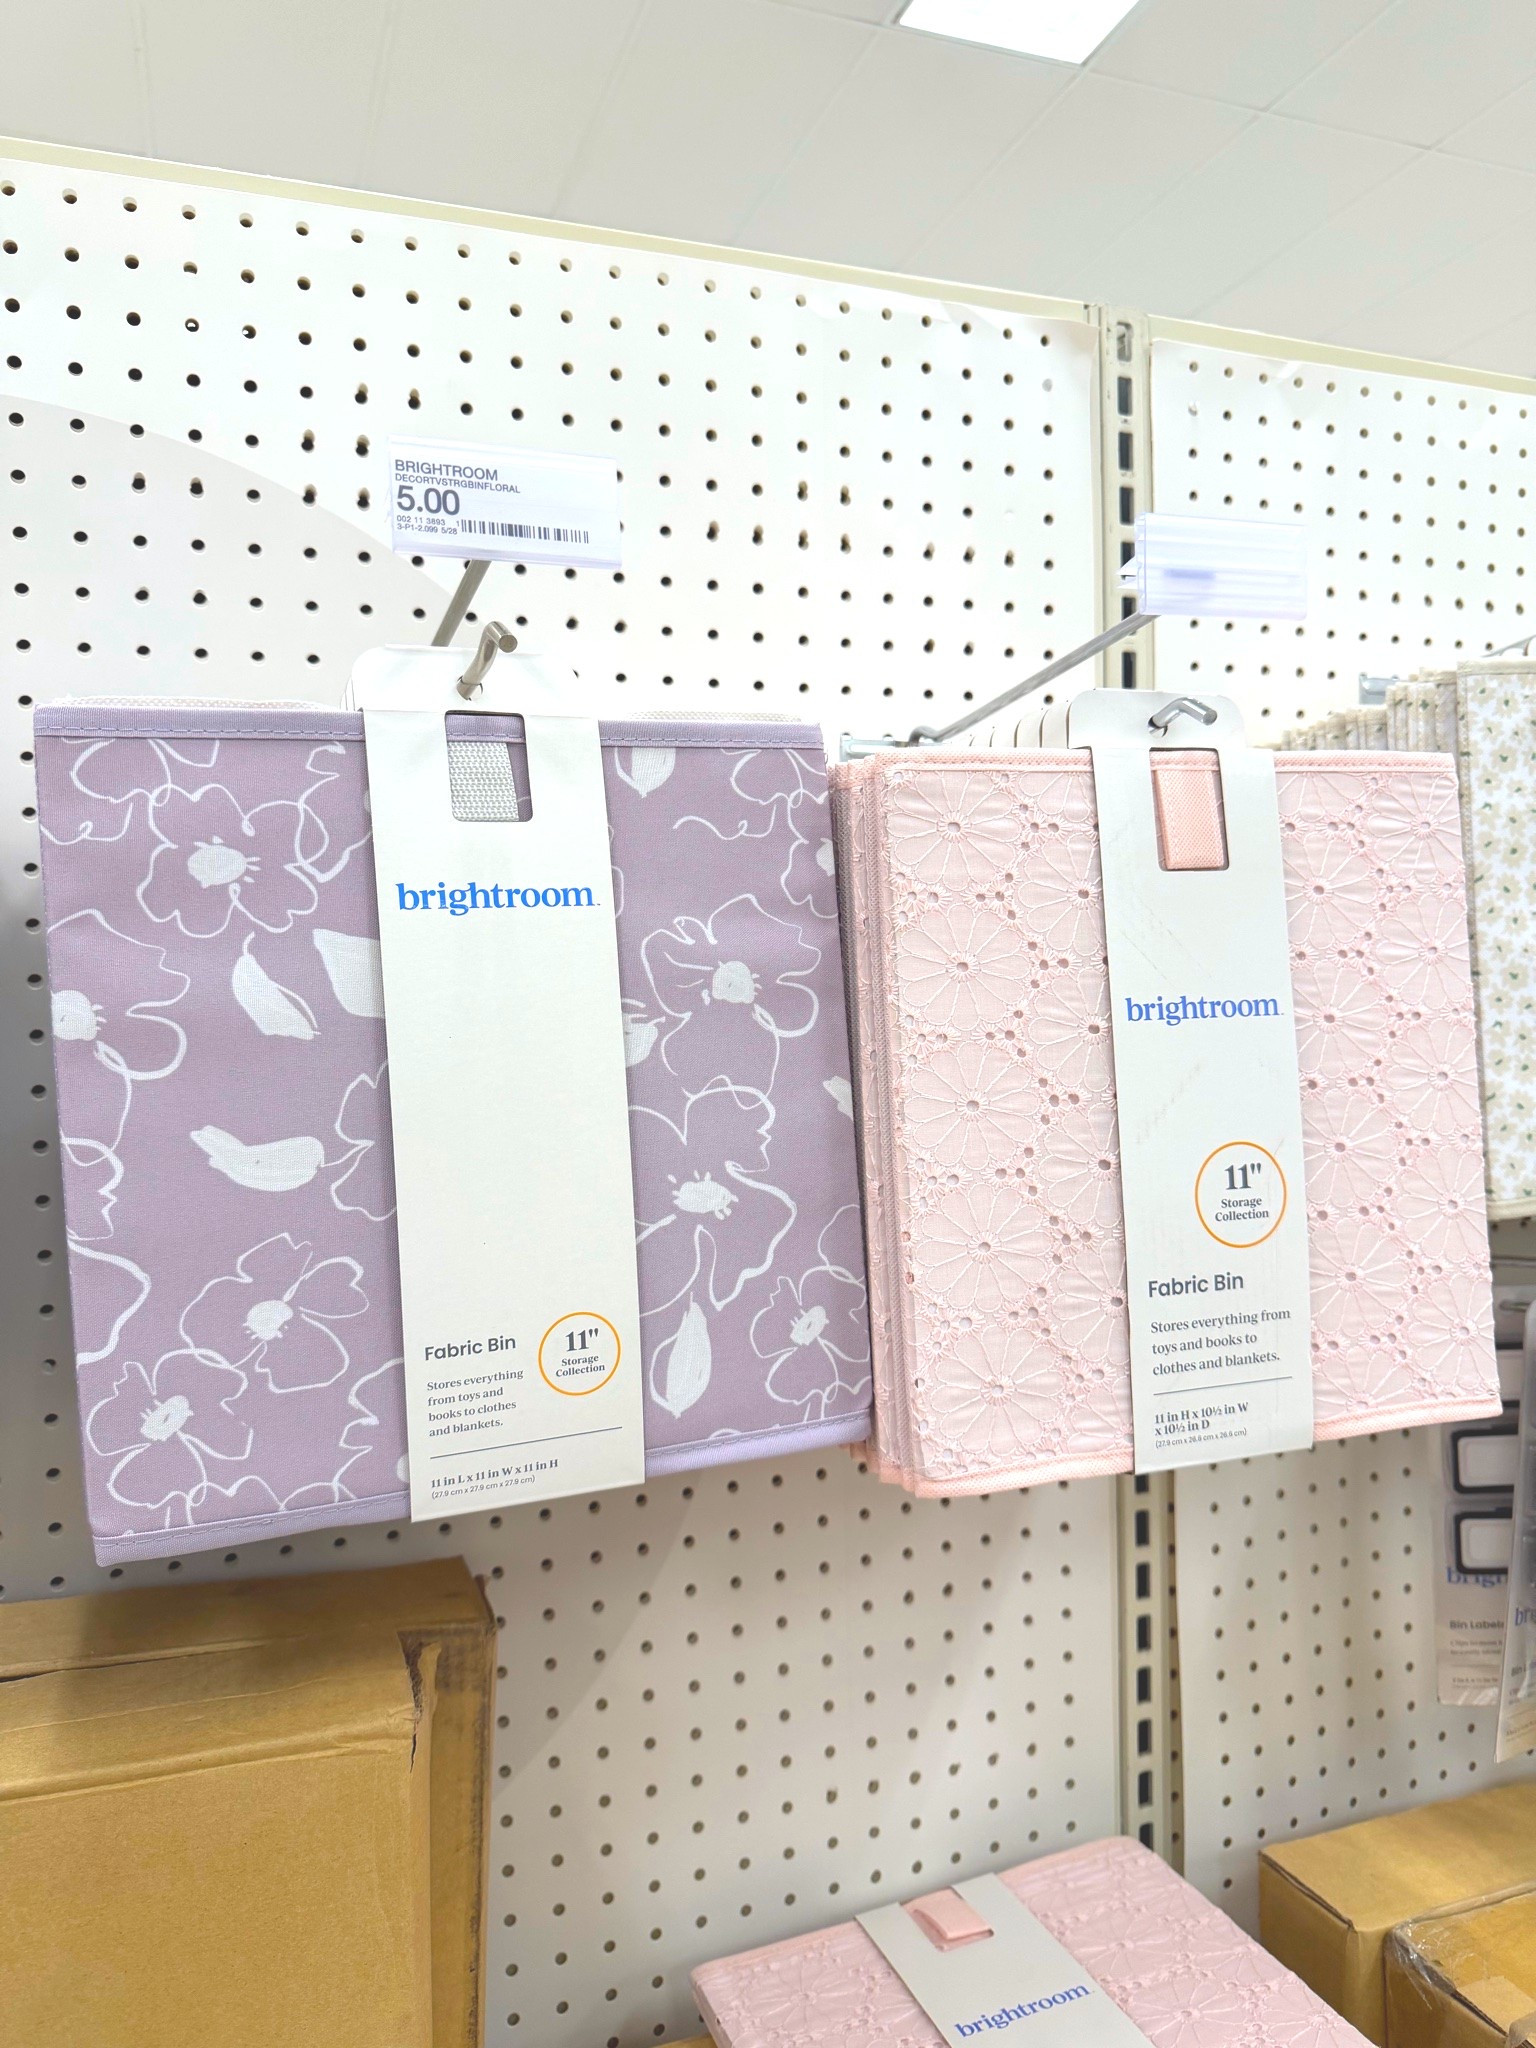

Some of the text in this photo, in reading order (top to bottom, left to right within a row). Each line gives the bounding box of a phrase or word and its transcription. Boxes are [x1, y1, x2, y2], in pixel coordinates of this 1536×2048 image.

[395, 459, 498, 481] BRIGHTROOM
[395, 473, 520, 493] DECORTVSTRGBINFLORAL
[397, 485, 460, 516] 5.00
[397, 515, 411, 523] 002
[426, 518, 446, 526] 3893
[441, 527, 458, 535] 5/28
[395, 882, 597, 916] brightroom
[1125, 995, 1282, 1026] brightroom
[1224, 1162, 1262, 1190] 11"
[1221, 1197, 1262, 1209] Storage
[1215, 1208, 1269, 1222] Collection
[1148, 1271, 1244, 1298] Fabric Bin
[1150, 1309, 1291, 1334] Stores everything from
[425, 1335, 516, 1361] Fabric Bin
[565, 1327, 599, 1352] 11"
[1152, 1333, 1258, 1356] toys and books to
[555, 1364, 605, 1378] Collection
[561, 1354, 599, 1367] Storage
[1153, 1351, 1280, 1376] clothes and blankets.
[427, 1369, 524, 1391] Stores everything
[427, 1386, 504, 1407] from toys and
[428, 1400, 517, 1422] books to clothes
[1155, 1414, 1164, 1424] 11
[1167, 1411, 1179, 1422] in
[1181, 1409, 1190, 1420] H
[1192, 1411, 1199, 1419] x
[1224, 1404, 1235, 1414] in
[1237, 1401, 1249, 1412] W
[429, 1417, 504, 1437] and blankets.
[1155, 1428, 1161, 1436] x
[1187, 1420, 1199, 1431] in
[1201, 1419, 1210, 1430] D
[1234, 1427, 1247, 1436] cm)
[431, 1479, 441, 1488] 11
[443, 1476, 455, 1486] in
[458, 1475, 465, 1484] L
[475, 1471, 485, 1481] 11
[487, 1469, 499, 1479] in
[502, 1466, 514, 1476] W
[515, 1466, 522, 1474] x
[524, 1463, 533, 1472] 11
[535, 1461, 547, 1471] in
[549, 1459, 558, 1468] H
[431, 1490, 449, 1500] (27.9
[470, 1484, 484, 1493] 27.9
[505, 1478, 519, 1487] 27.9
[520, 1475, 536, 1485] cm)
[954, 1984, 1090, 2037] brightroom
